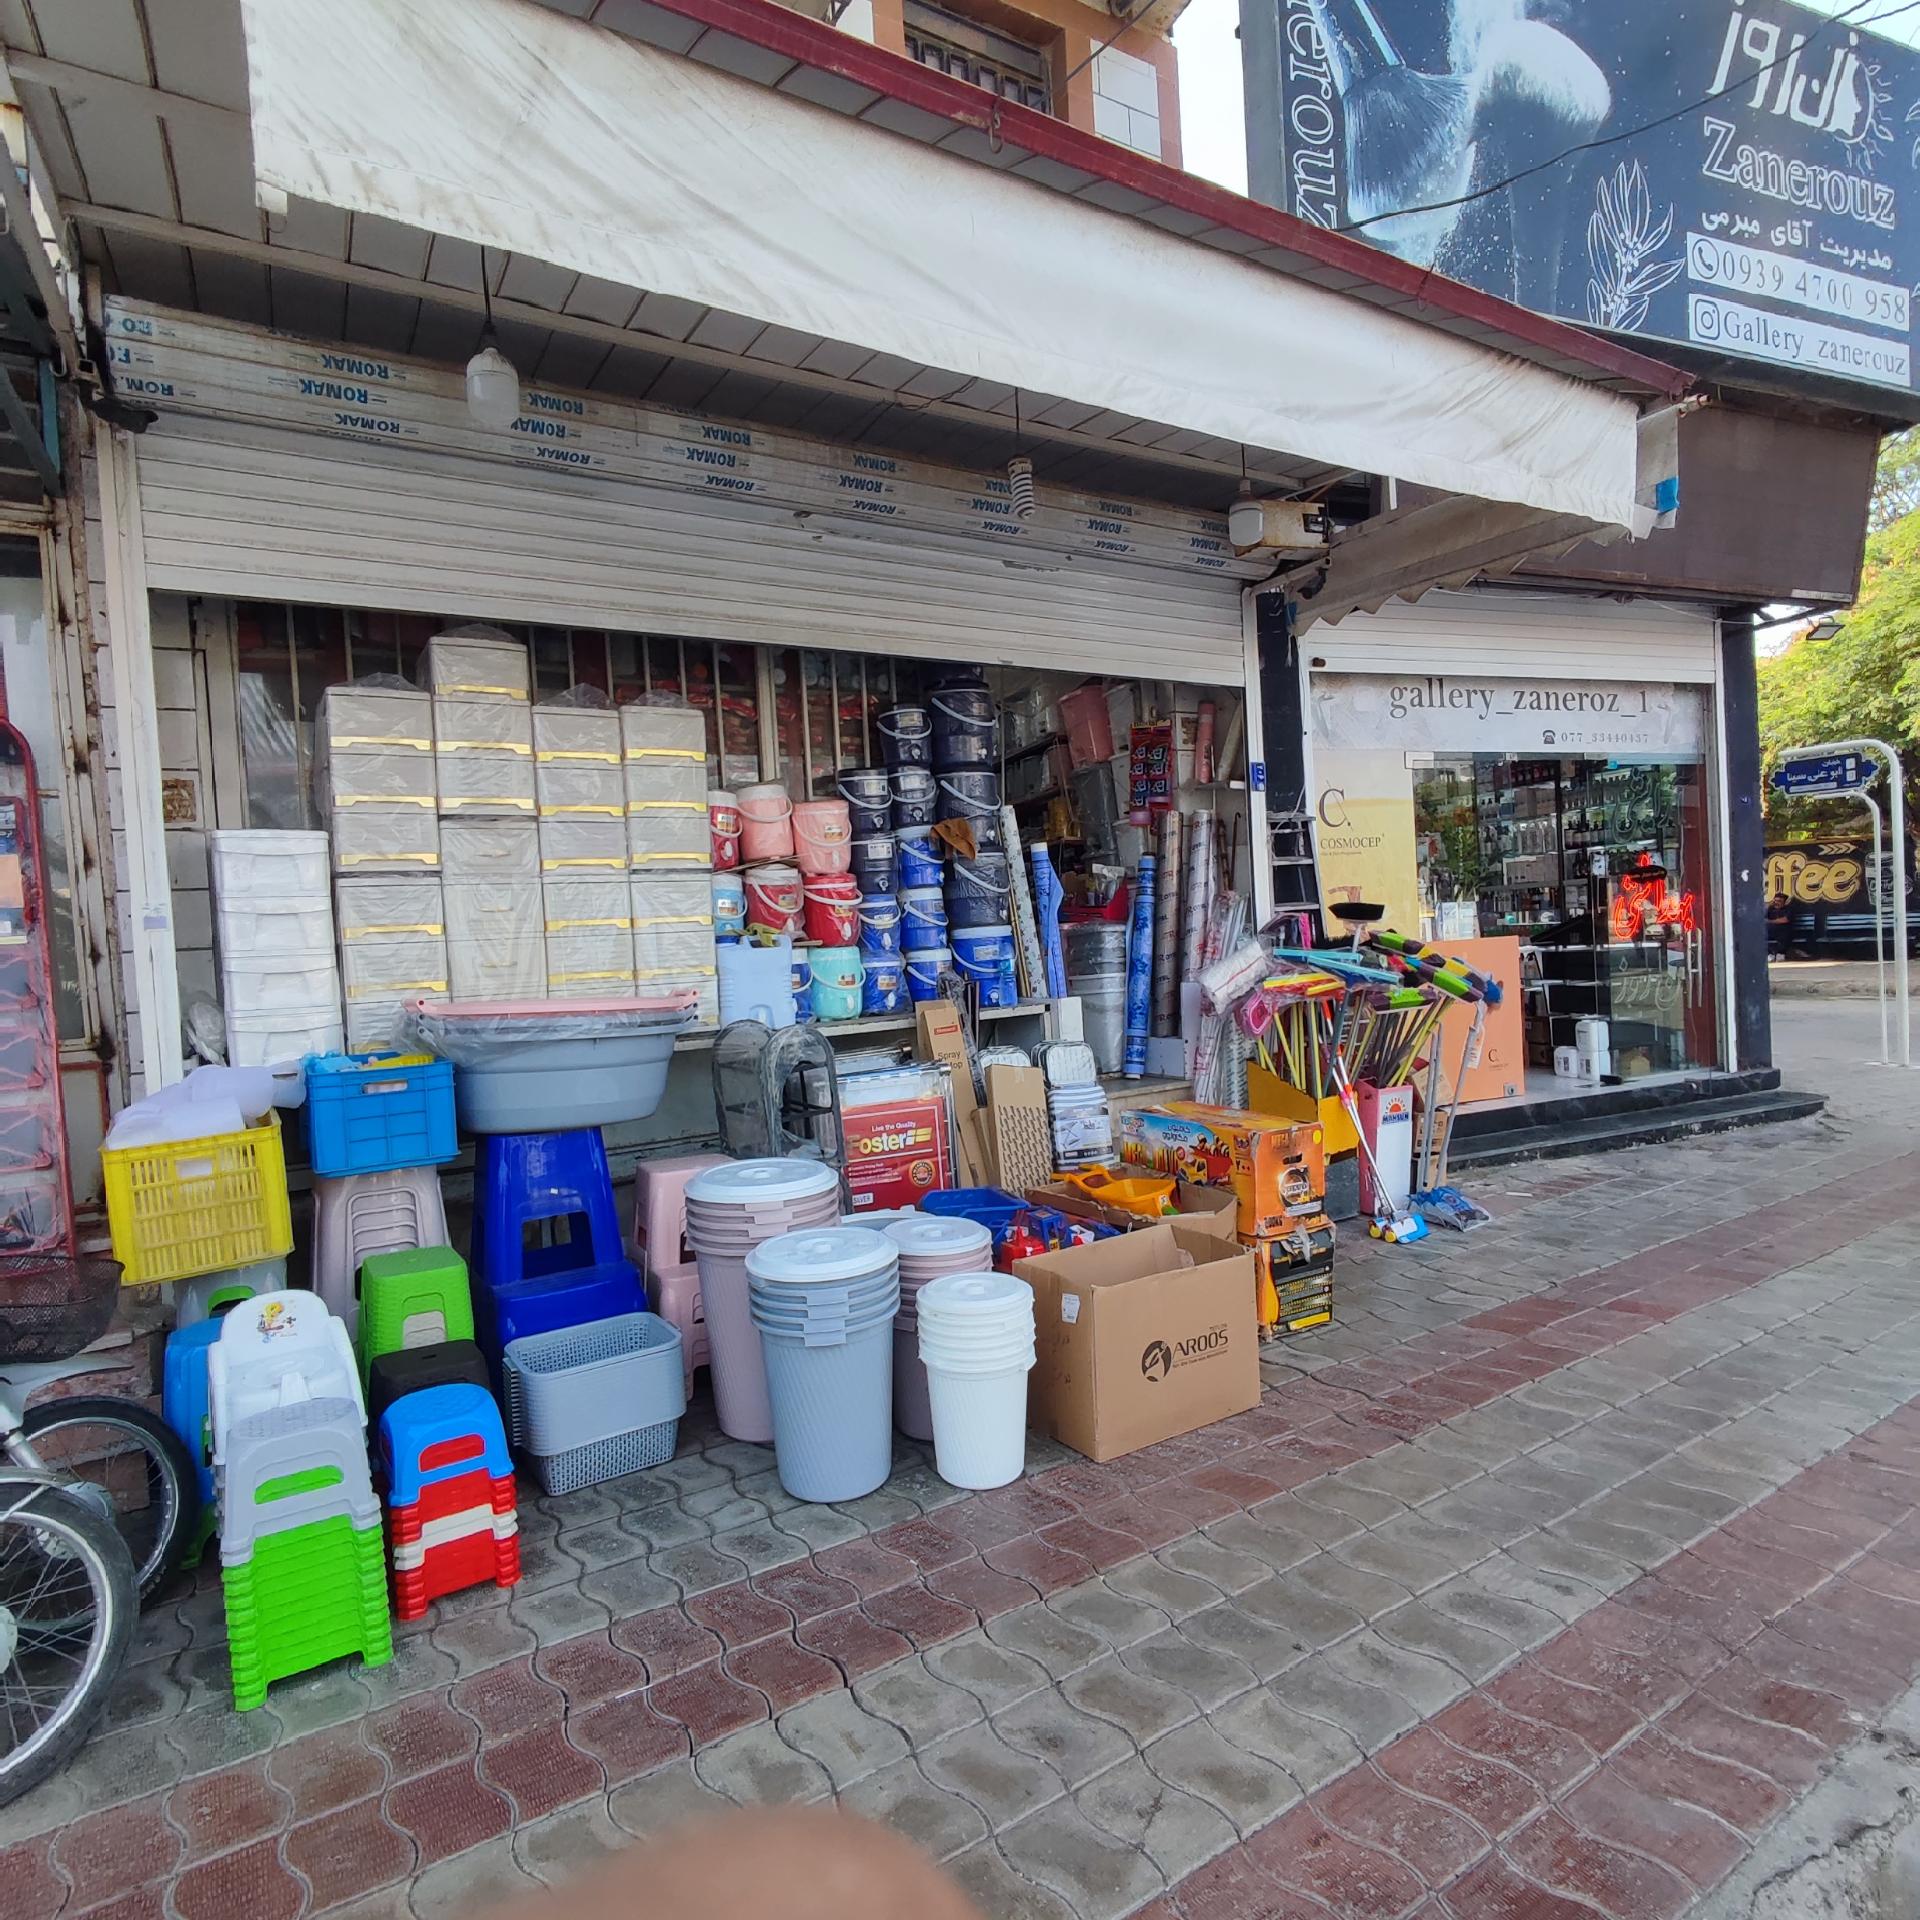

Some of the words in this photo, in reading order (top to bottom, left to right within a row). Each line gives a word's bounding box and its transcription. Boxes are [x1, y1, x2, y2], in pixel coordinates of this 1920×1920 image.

[1286, 0, 1338, 230] erouz
[1702, 115, 1895, 230] Zanerouz
[1771, 219, 1813, 248] آقای
[1819, 233, 1893, 271] مدیریت
[1723, 251, 1784, 292] 0939
[1794, 271, 1853, 310] 4700
[1865, 288, 1906, 324] 958
[322, 353, 389, 380] ROMAK
[299, 378, 368, 404] ROMAK
[528, 392, 584, 415] ROMAK
[335, 412, 400, 434] ROMAK
[702, 425, 751, 446] ROMAK
[537, 446, 591, 465] ROMAK
[686, 447, 736, 468] ROMAK
[853, 454, 897, 473] ROMAK
[706, 475, 755, 492] ROMAK
[839, 474, 883, 493] ROMAK
[853, 500, 897, 515] ROMAK
[971, 498, 1011, 515] ROMAK
[1099, 500, 1133, 517] ROMAK
[982, 521, 1020, 535] ROMAK
[1088, 519, 1122, 534] ROMAK
[1094, 540, 1129, 552] ROMAK
[1190, 537, 1221, 552] ROMAK
[1195, 556, 1226, 568] ROMAK
[1389, 677, 1649, 720] gallery_zaneroz_1
[1763, 850, 1861, 903] ffee
[937, 1050, 960, 1062] Spray
[895, 1120, 917, 1130] Quality
[1173, 1329, 1229, 1359] AROOS
